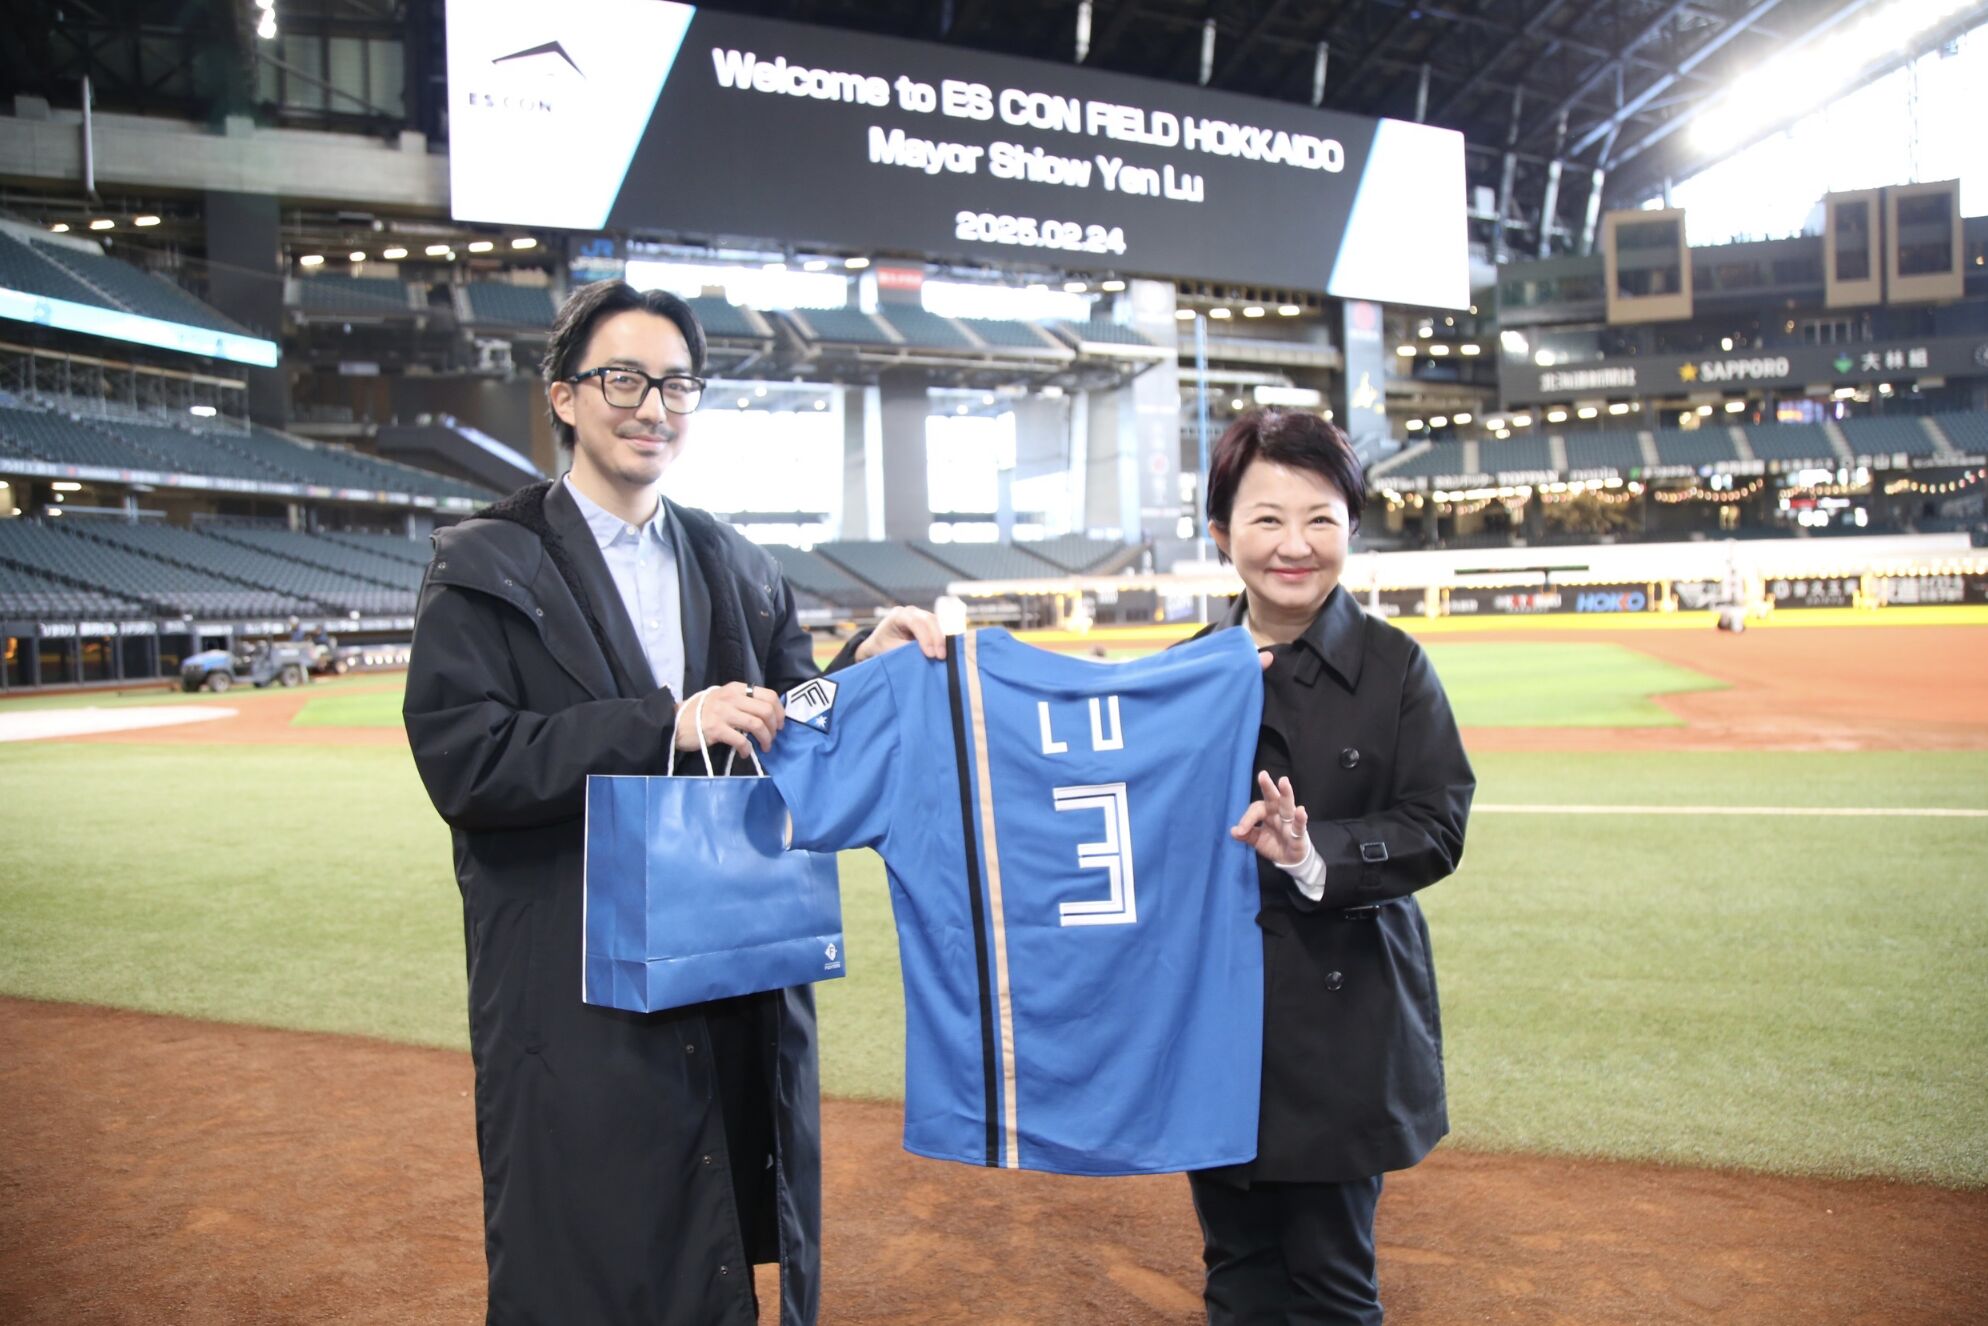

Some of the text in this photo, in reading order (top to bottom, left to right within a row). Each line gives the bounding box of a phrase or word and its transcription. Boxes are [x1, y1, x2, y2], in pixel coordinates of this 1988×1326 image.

[711, 47, 1345, 173] Welcome to ES CON FIELD HOKKAIDO
[868, 125, 1205, 203] Mayor Shiow Yen Lu
[955, 210, 1127, 256] 2025.02.24
[1700, 357, 1790, 382] SAPPORO
[1861, 348, 1929, 372] 大林組
[1036, 695, 1123, 754] LU
[1052, 782, 1138, 928] 3
